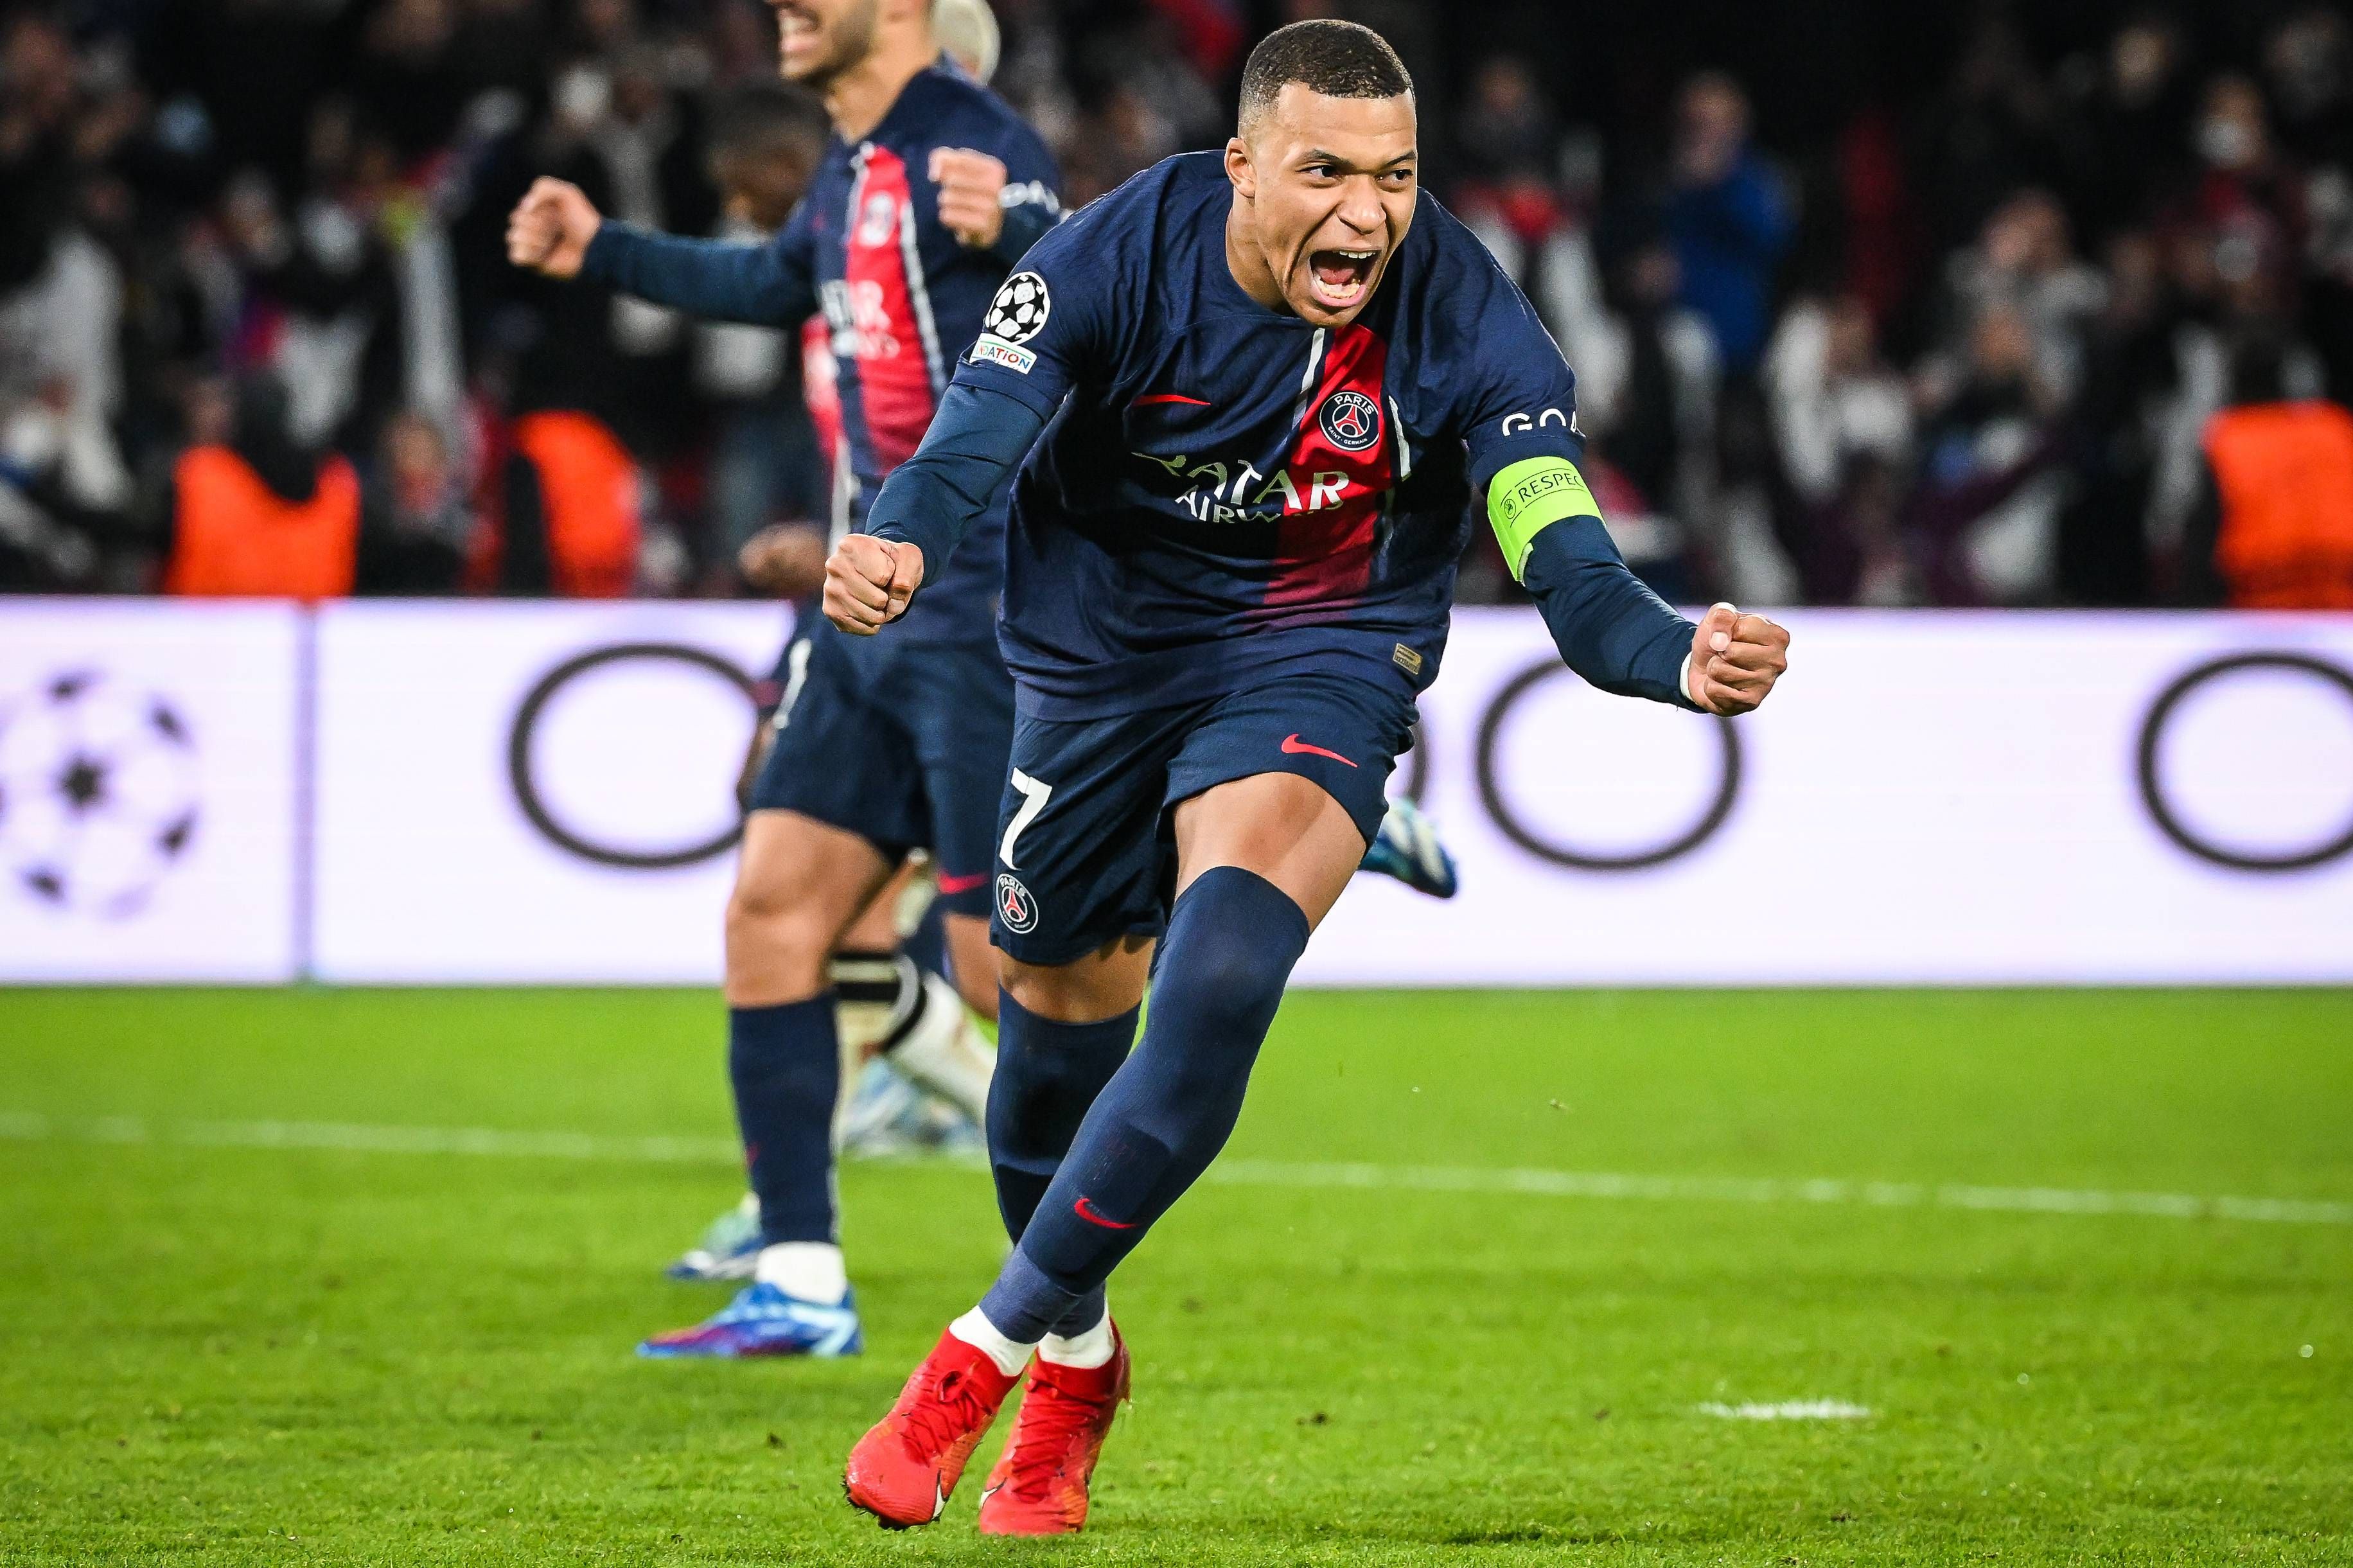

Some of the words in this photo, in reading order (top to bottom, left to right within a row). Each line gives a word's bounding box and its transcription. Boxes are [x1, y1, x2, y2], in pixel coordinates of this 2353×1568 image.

[1334, 394, 1374, 415] PARIS
[1328, 425, 1341, 441] SAINT
[1131, 452, 1350, 511] ATAR
[1518, 473, 1585, 502] RESPEC
[999, 766, 1053, 871] 7
[1000, 877, 1027, 897] PARIS
